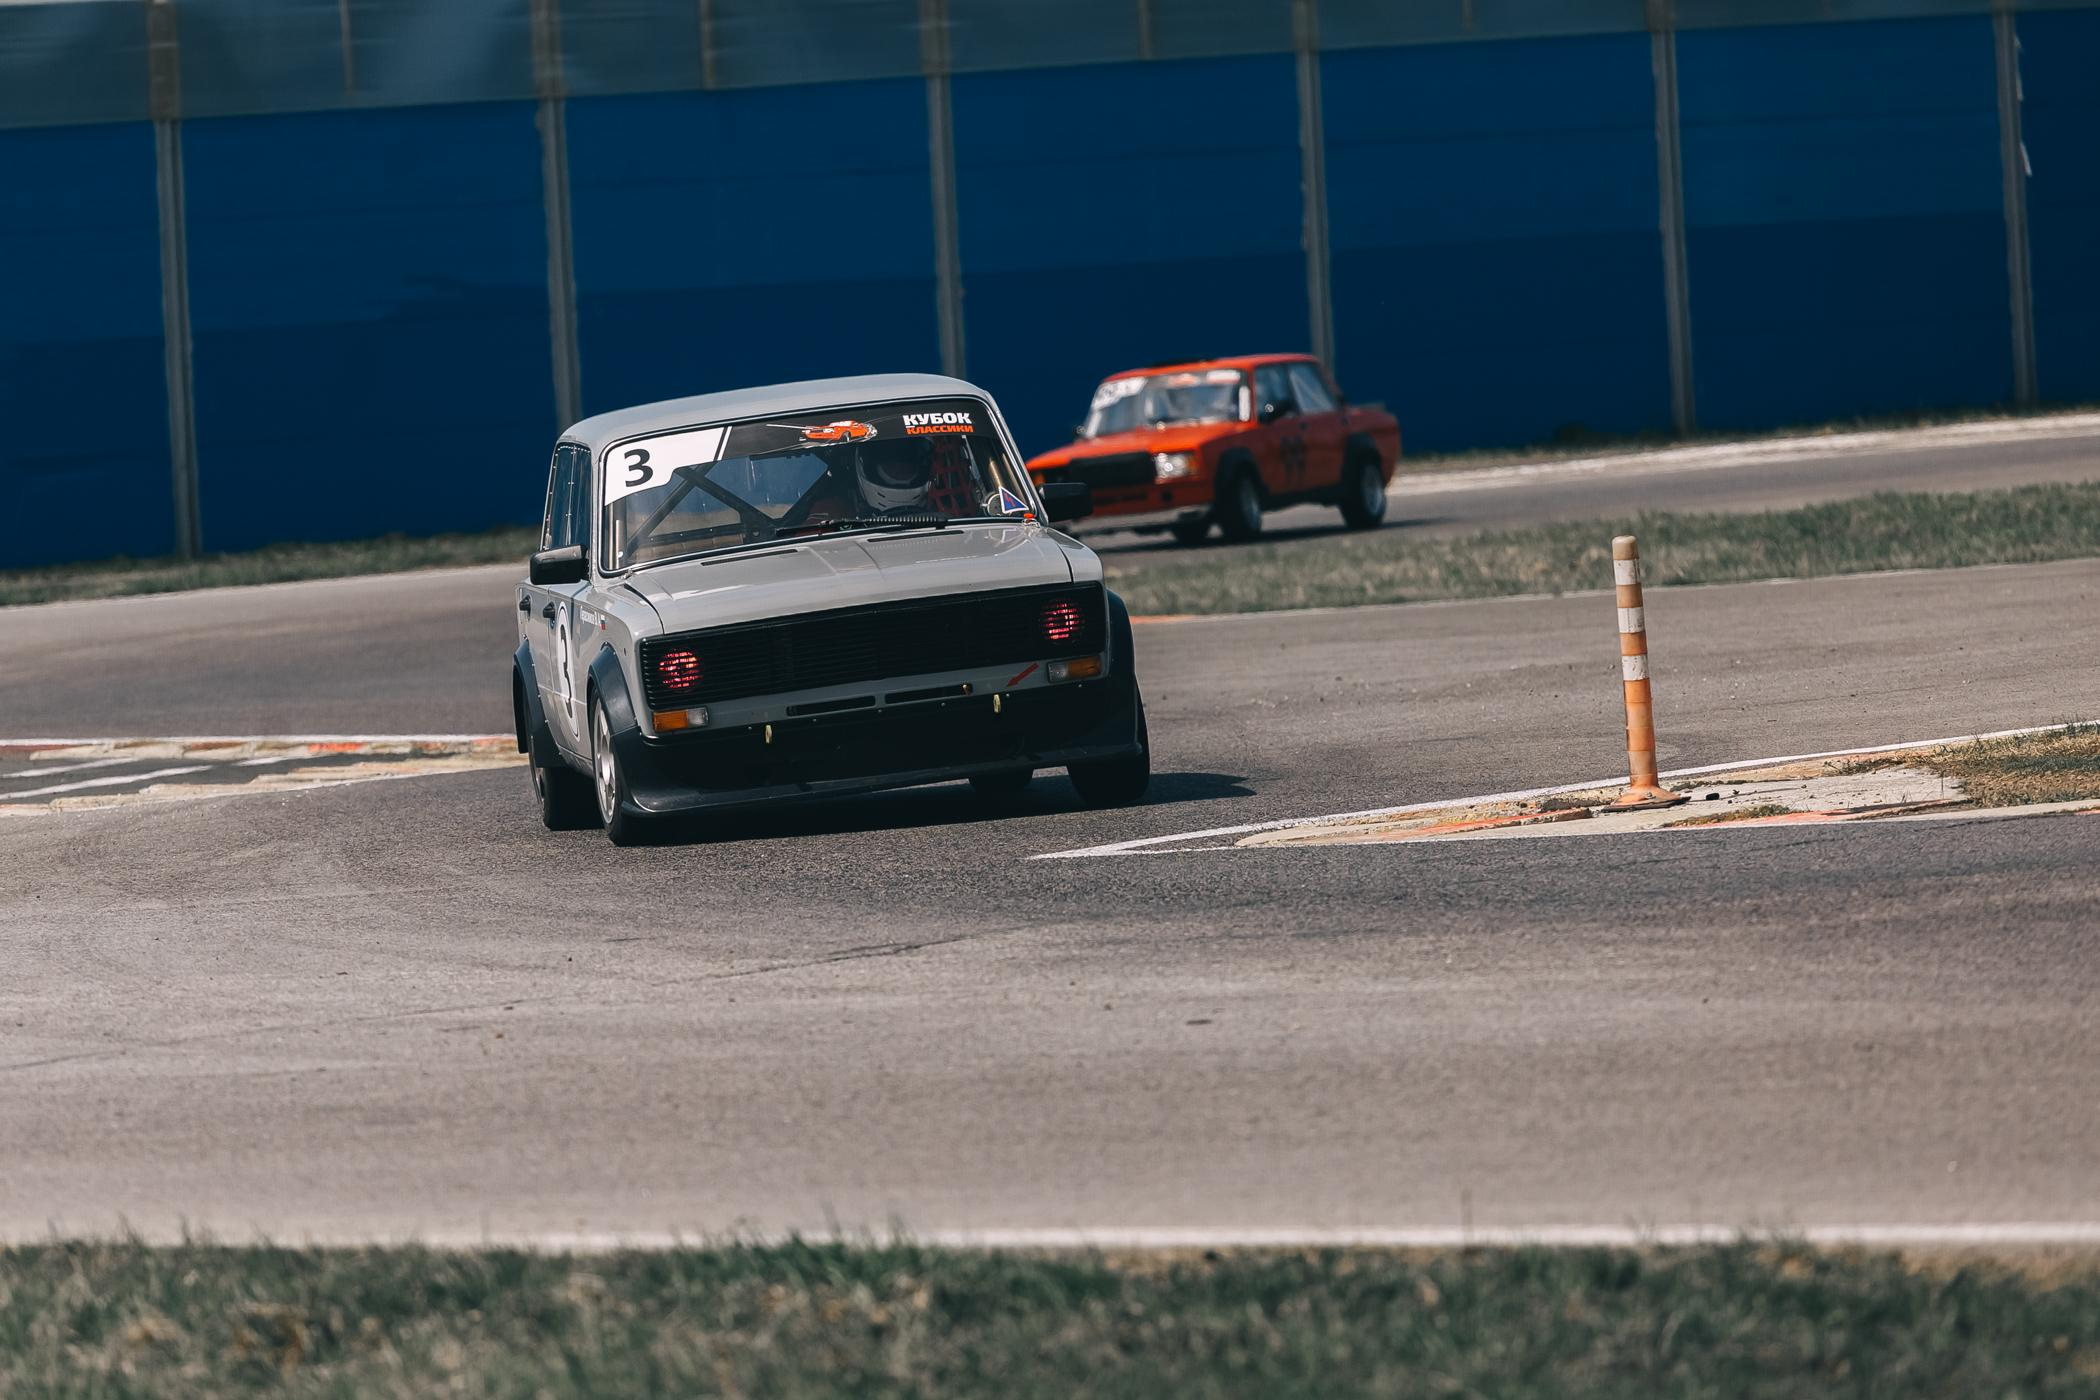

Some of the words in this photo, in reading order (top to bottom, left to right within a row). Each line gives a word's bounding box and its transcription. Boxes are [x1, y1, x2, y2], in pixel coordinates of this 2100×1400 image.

[903, 412, 972, 425] КУБОК
[907, 425, 973, 435] КЛАССИКИ
[624, 449, 653, 487] 3
[560, 624, 573, 719] 3
